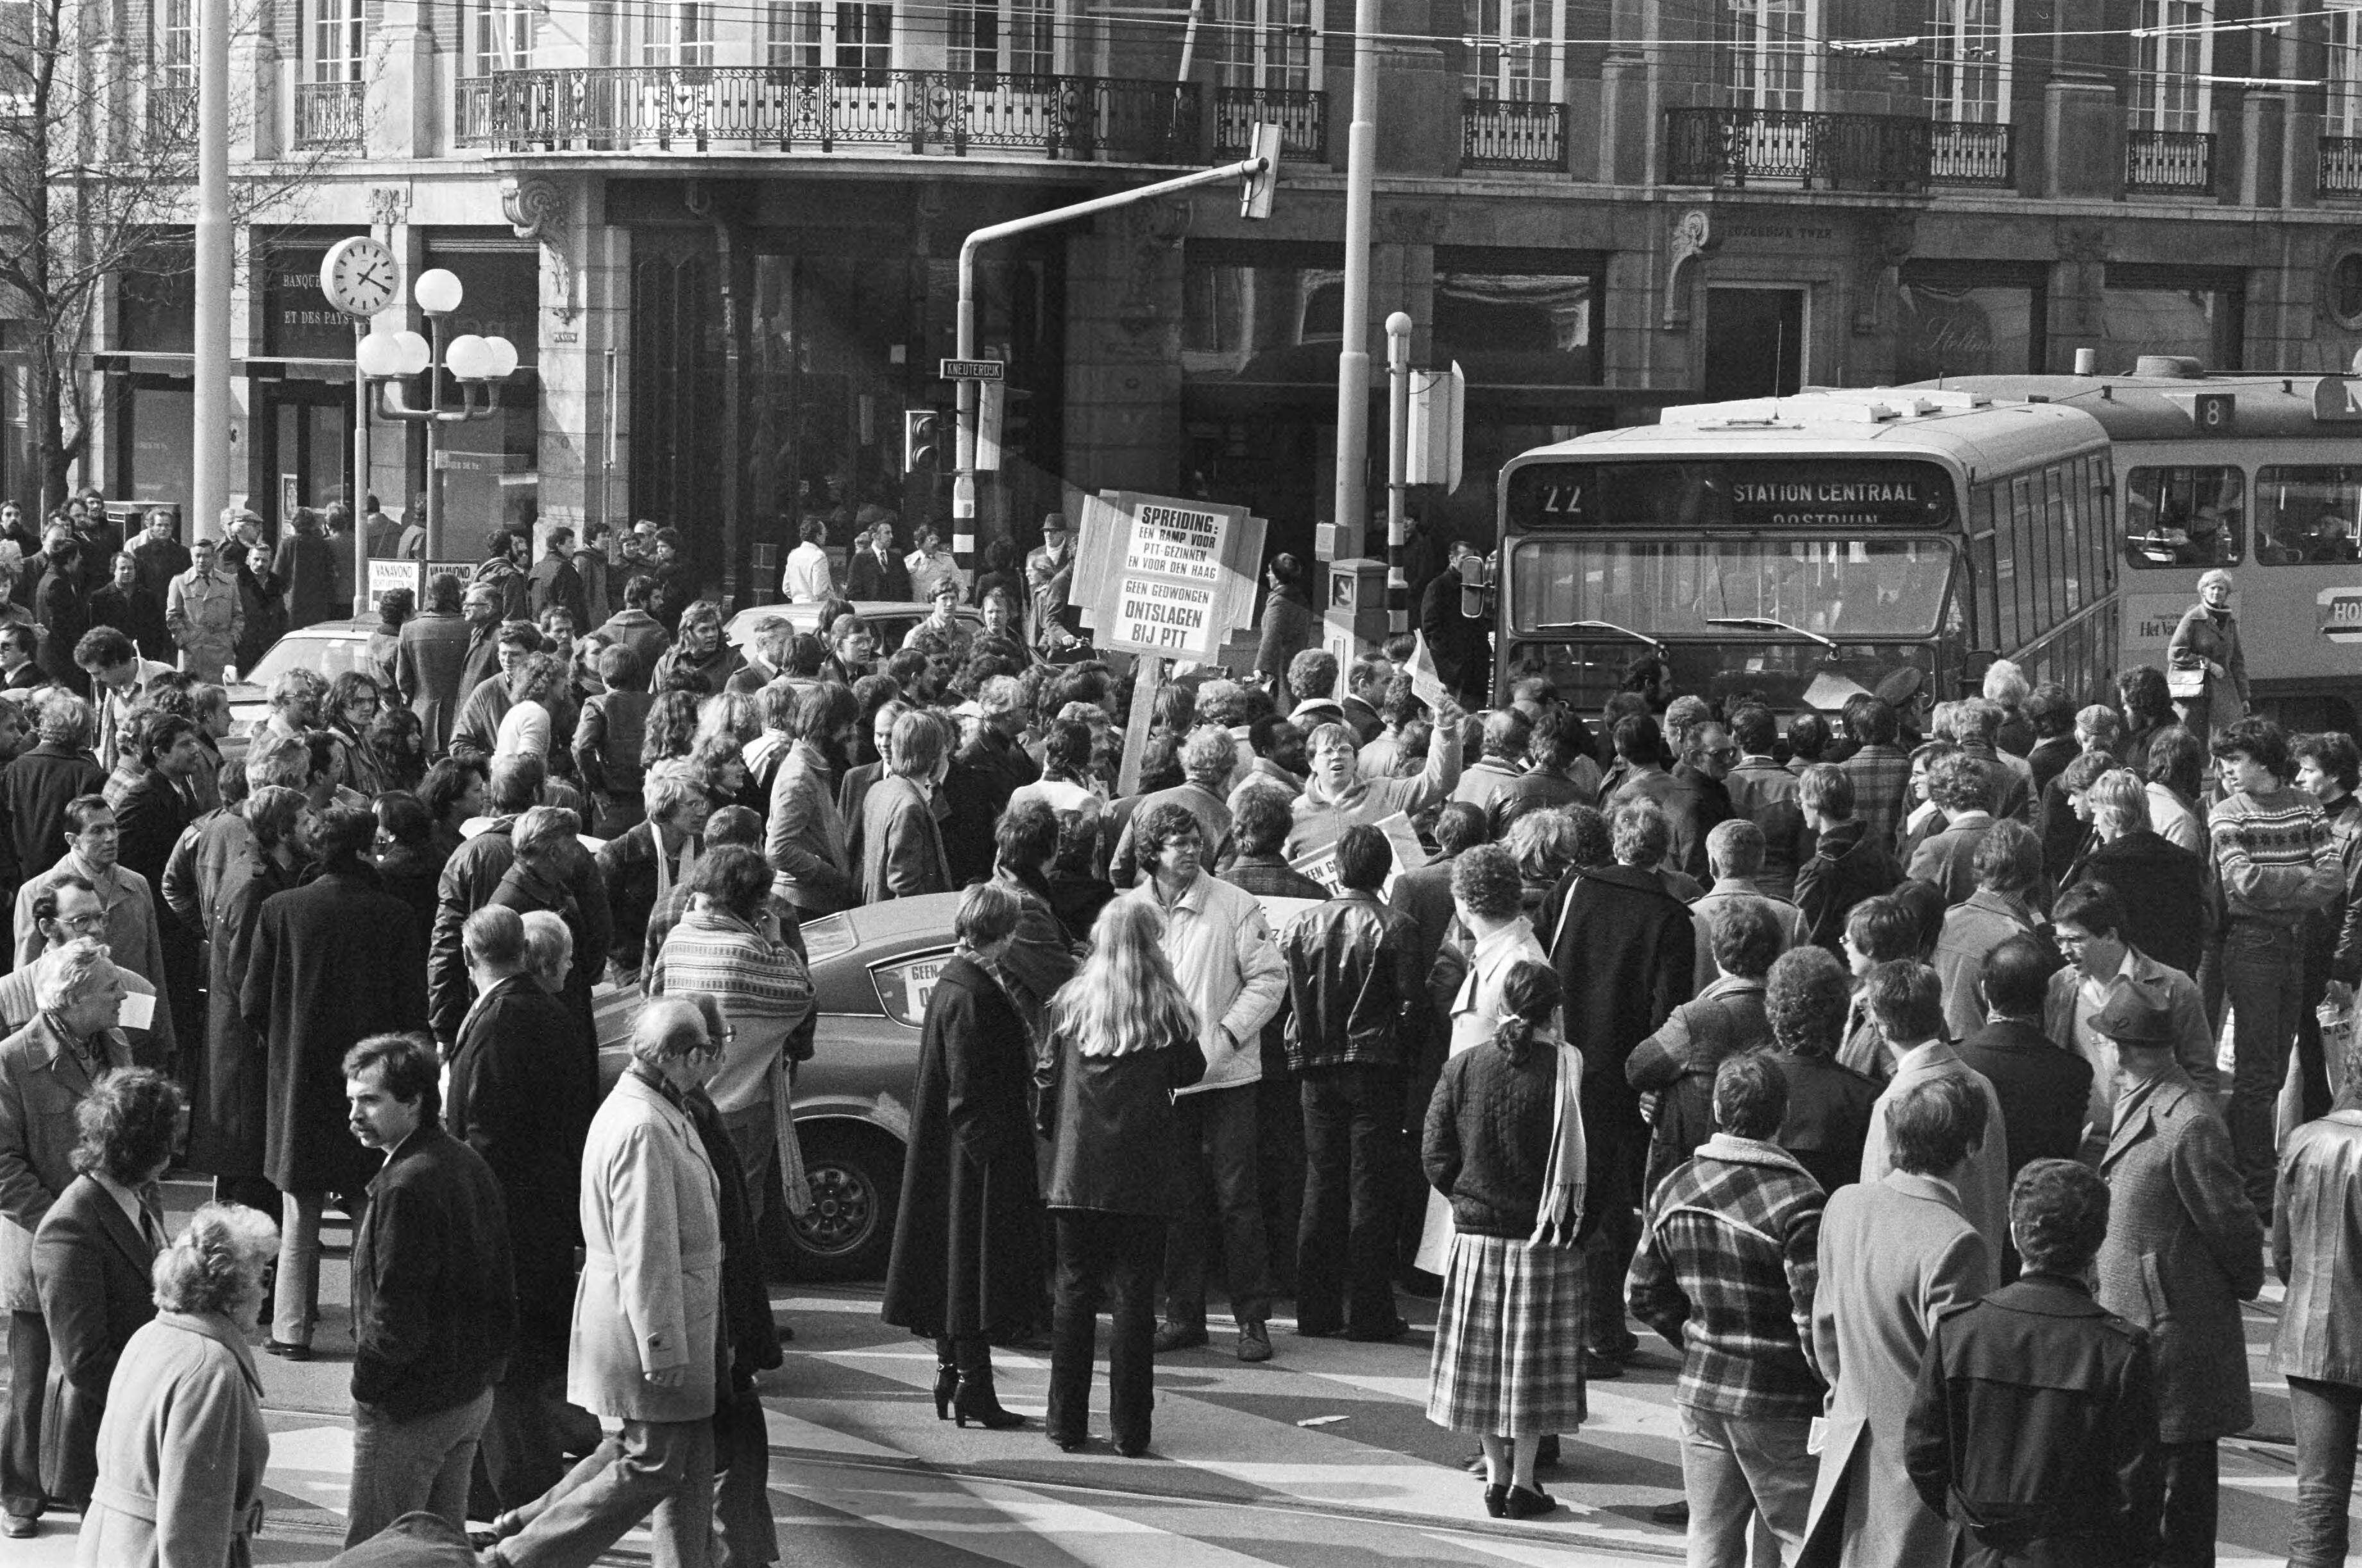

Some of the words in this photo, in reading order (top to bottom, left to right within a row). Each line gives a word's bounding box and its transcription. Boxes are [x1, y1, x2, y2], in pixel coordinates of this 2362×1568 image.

[284, 311, 298, 324] ET
[301, 311, 320, 324] DES
[2207, 399, 2219, 425] 8
[1543, 485, 1581, 512] 22
[1733, 483, 1813, 502] STATION
[1818, 482, 1917, 502] CENTRAAL
[1142, 507, 1218, 534] SPREIDING:
[1139, 527, 1155, 539] EEN
[1159, 529, 1186, 543] RAMP
[1191, 534, 1216, 549] VOOR
[1144, 543, 1207, 562] PTT-GEZINNEN
[375, 564, 412, 578] VANAVOND
[1128, 555, 1139, 568] EN
[1143, 557, 1166, 571] VOOR
[1170, 561, 1187, 575] DEN
[1191, 565, 1216, 578] HAAG
[1126, 580, 1148, 595] GEEN
[1151, 584, 1209, 603] GEDWONGEN
[1125, 600, 1203, 628] ONTSLAGEN
[2334, 602, 2362, 621] HO
[1132, 623, 1155, 644] BIJ
[1160, 627, 1187, 648] PTT
[912, 964, 938, 981] GEEN
